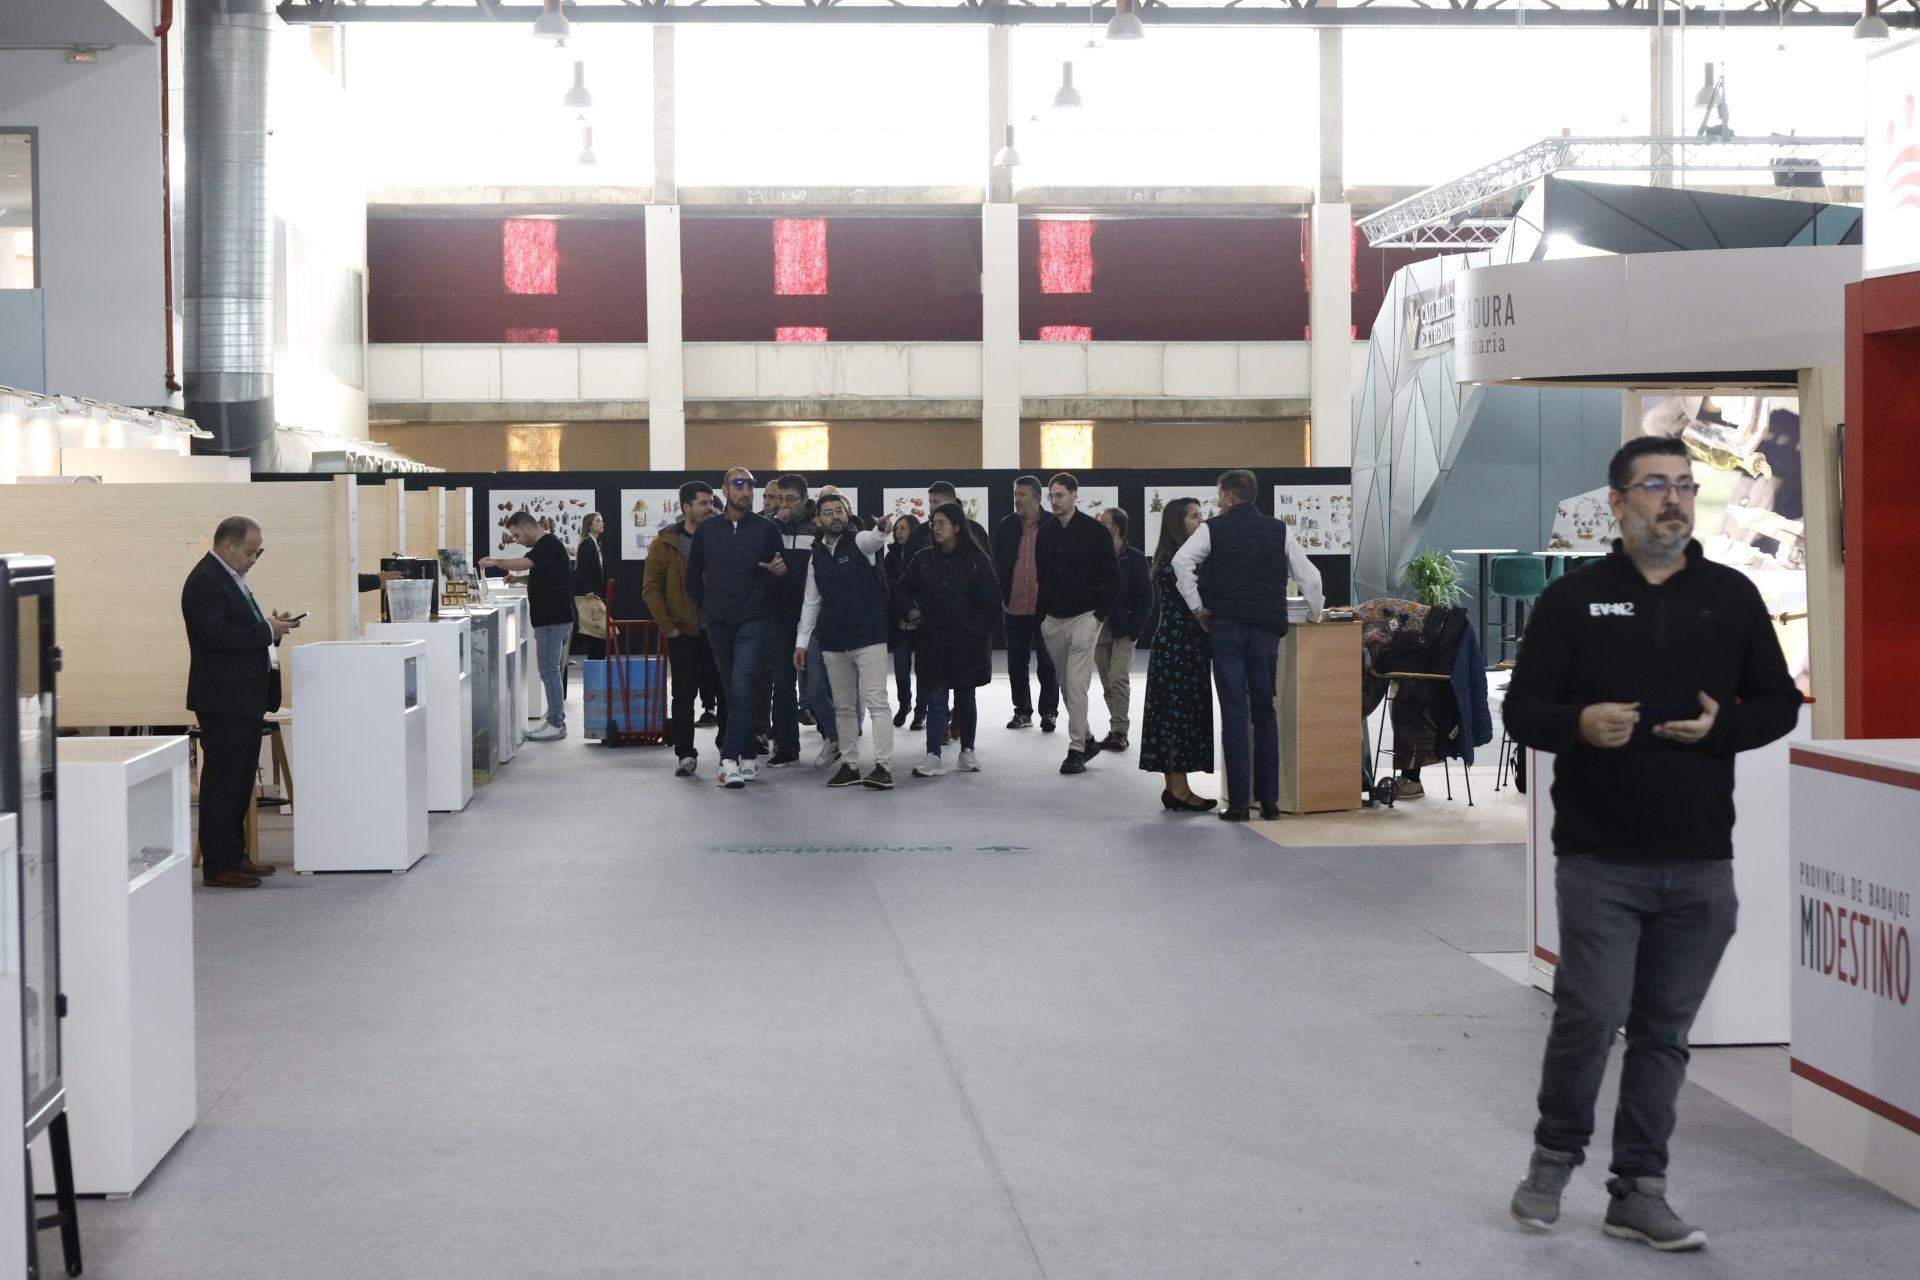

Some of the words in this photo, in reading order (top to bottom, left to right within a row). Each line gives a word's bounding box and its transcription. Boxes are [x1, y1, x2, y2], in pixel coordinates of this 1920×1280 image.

[1800, 862, 1845, 897] PROVINCIA
[1851, 877, 1862, 903] DE
[1869, 883, 1910, 920] BADAJOZ
